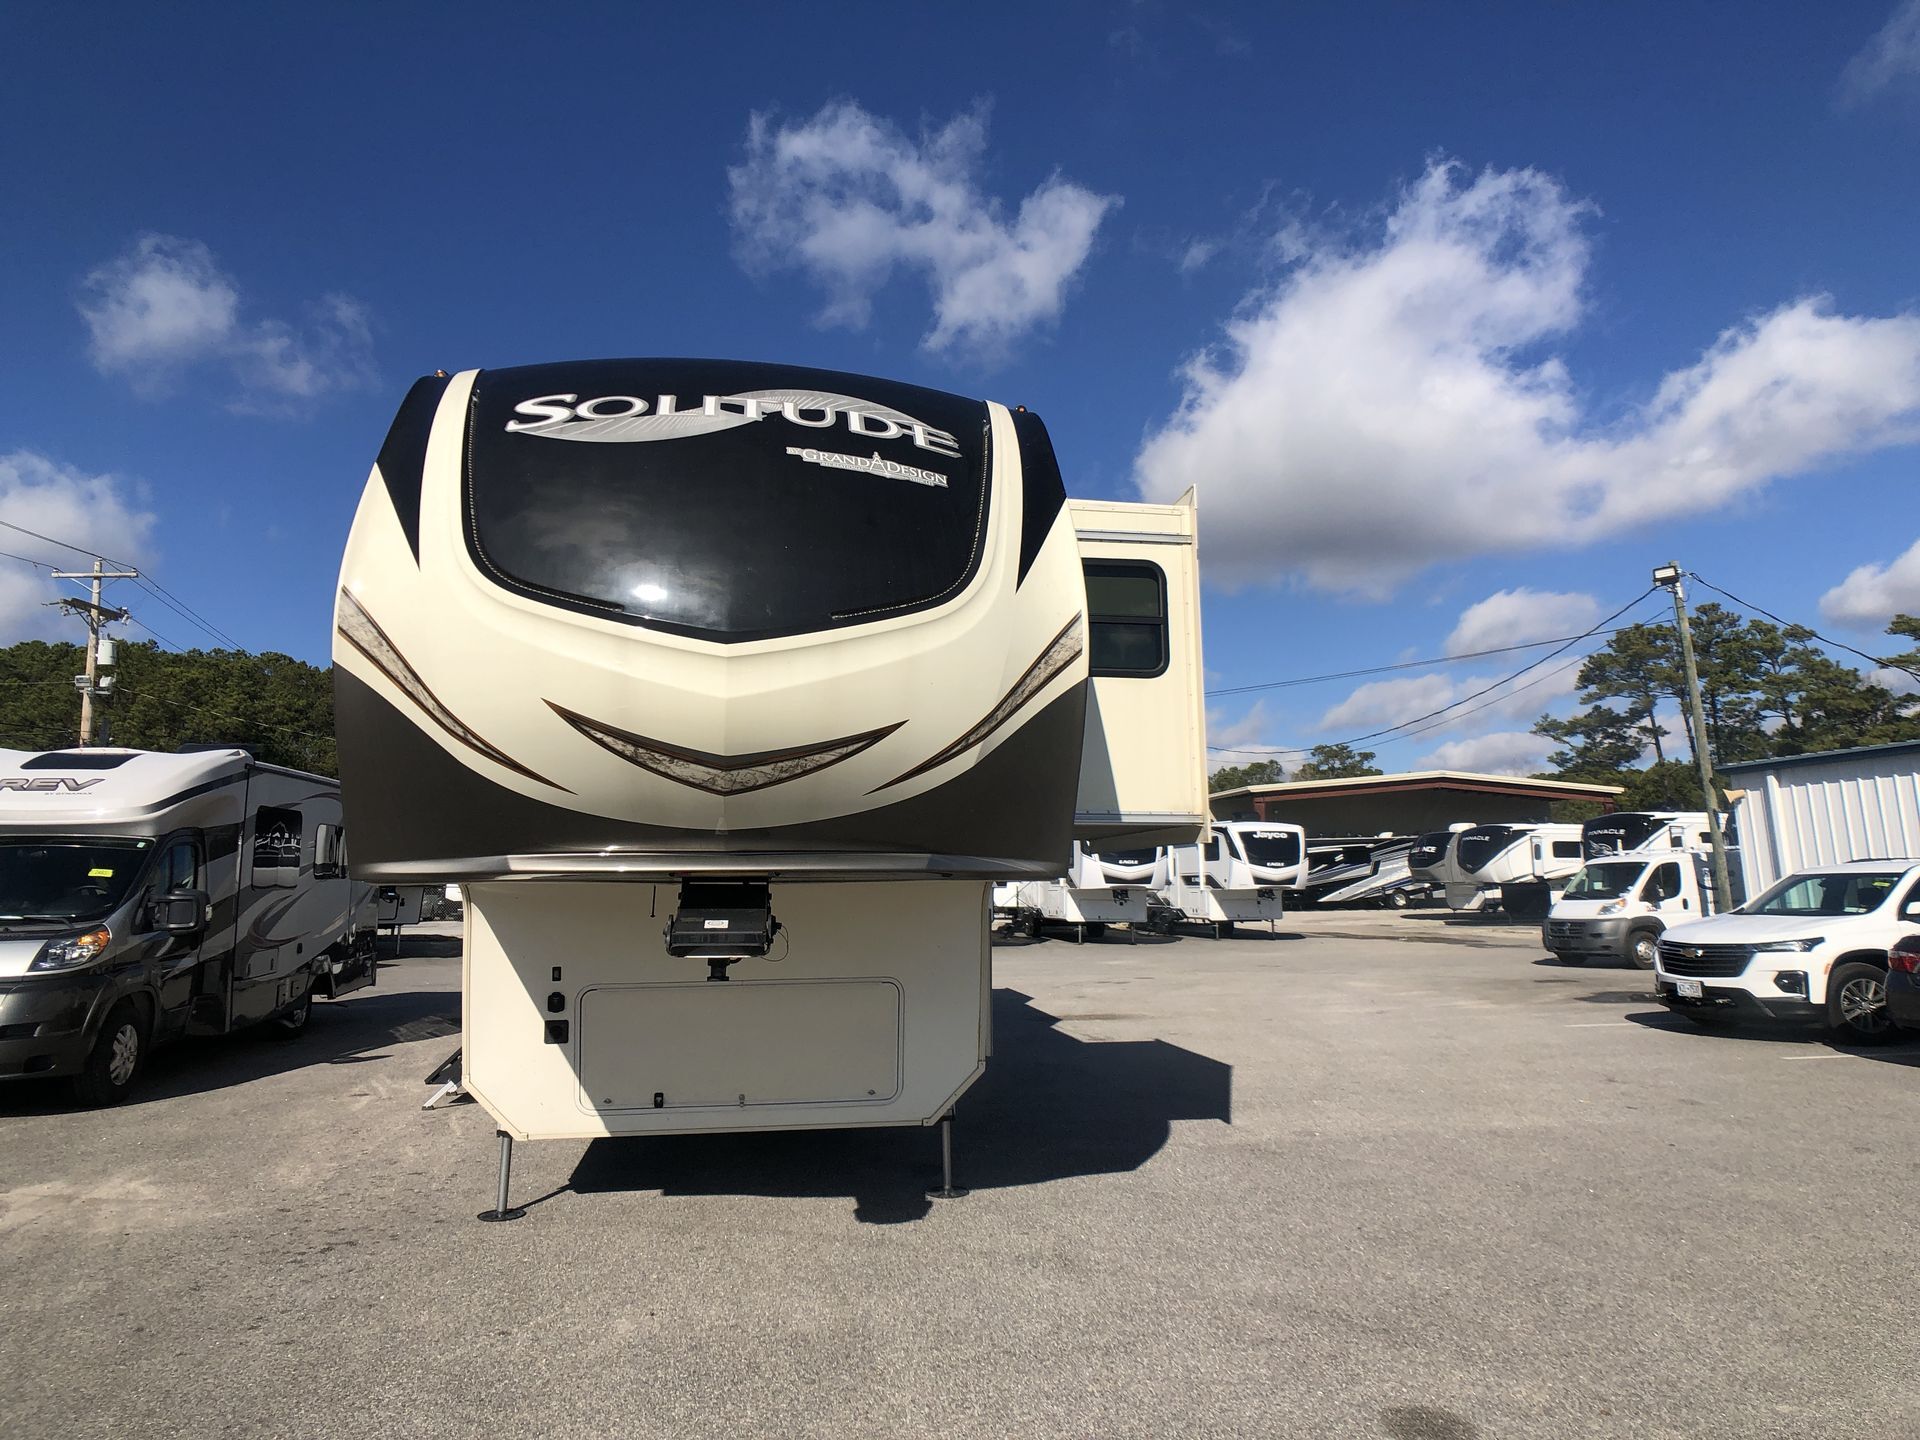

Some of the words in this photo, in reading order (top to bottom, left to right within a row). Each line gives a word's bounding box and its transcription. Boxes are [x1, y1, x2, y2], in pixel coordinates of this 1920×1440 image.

[505, 394, 962, 458] SOLITUDE
[0, 778, 106, 791] REV
[1253, 831, 1288, 840] Jayco
